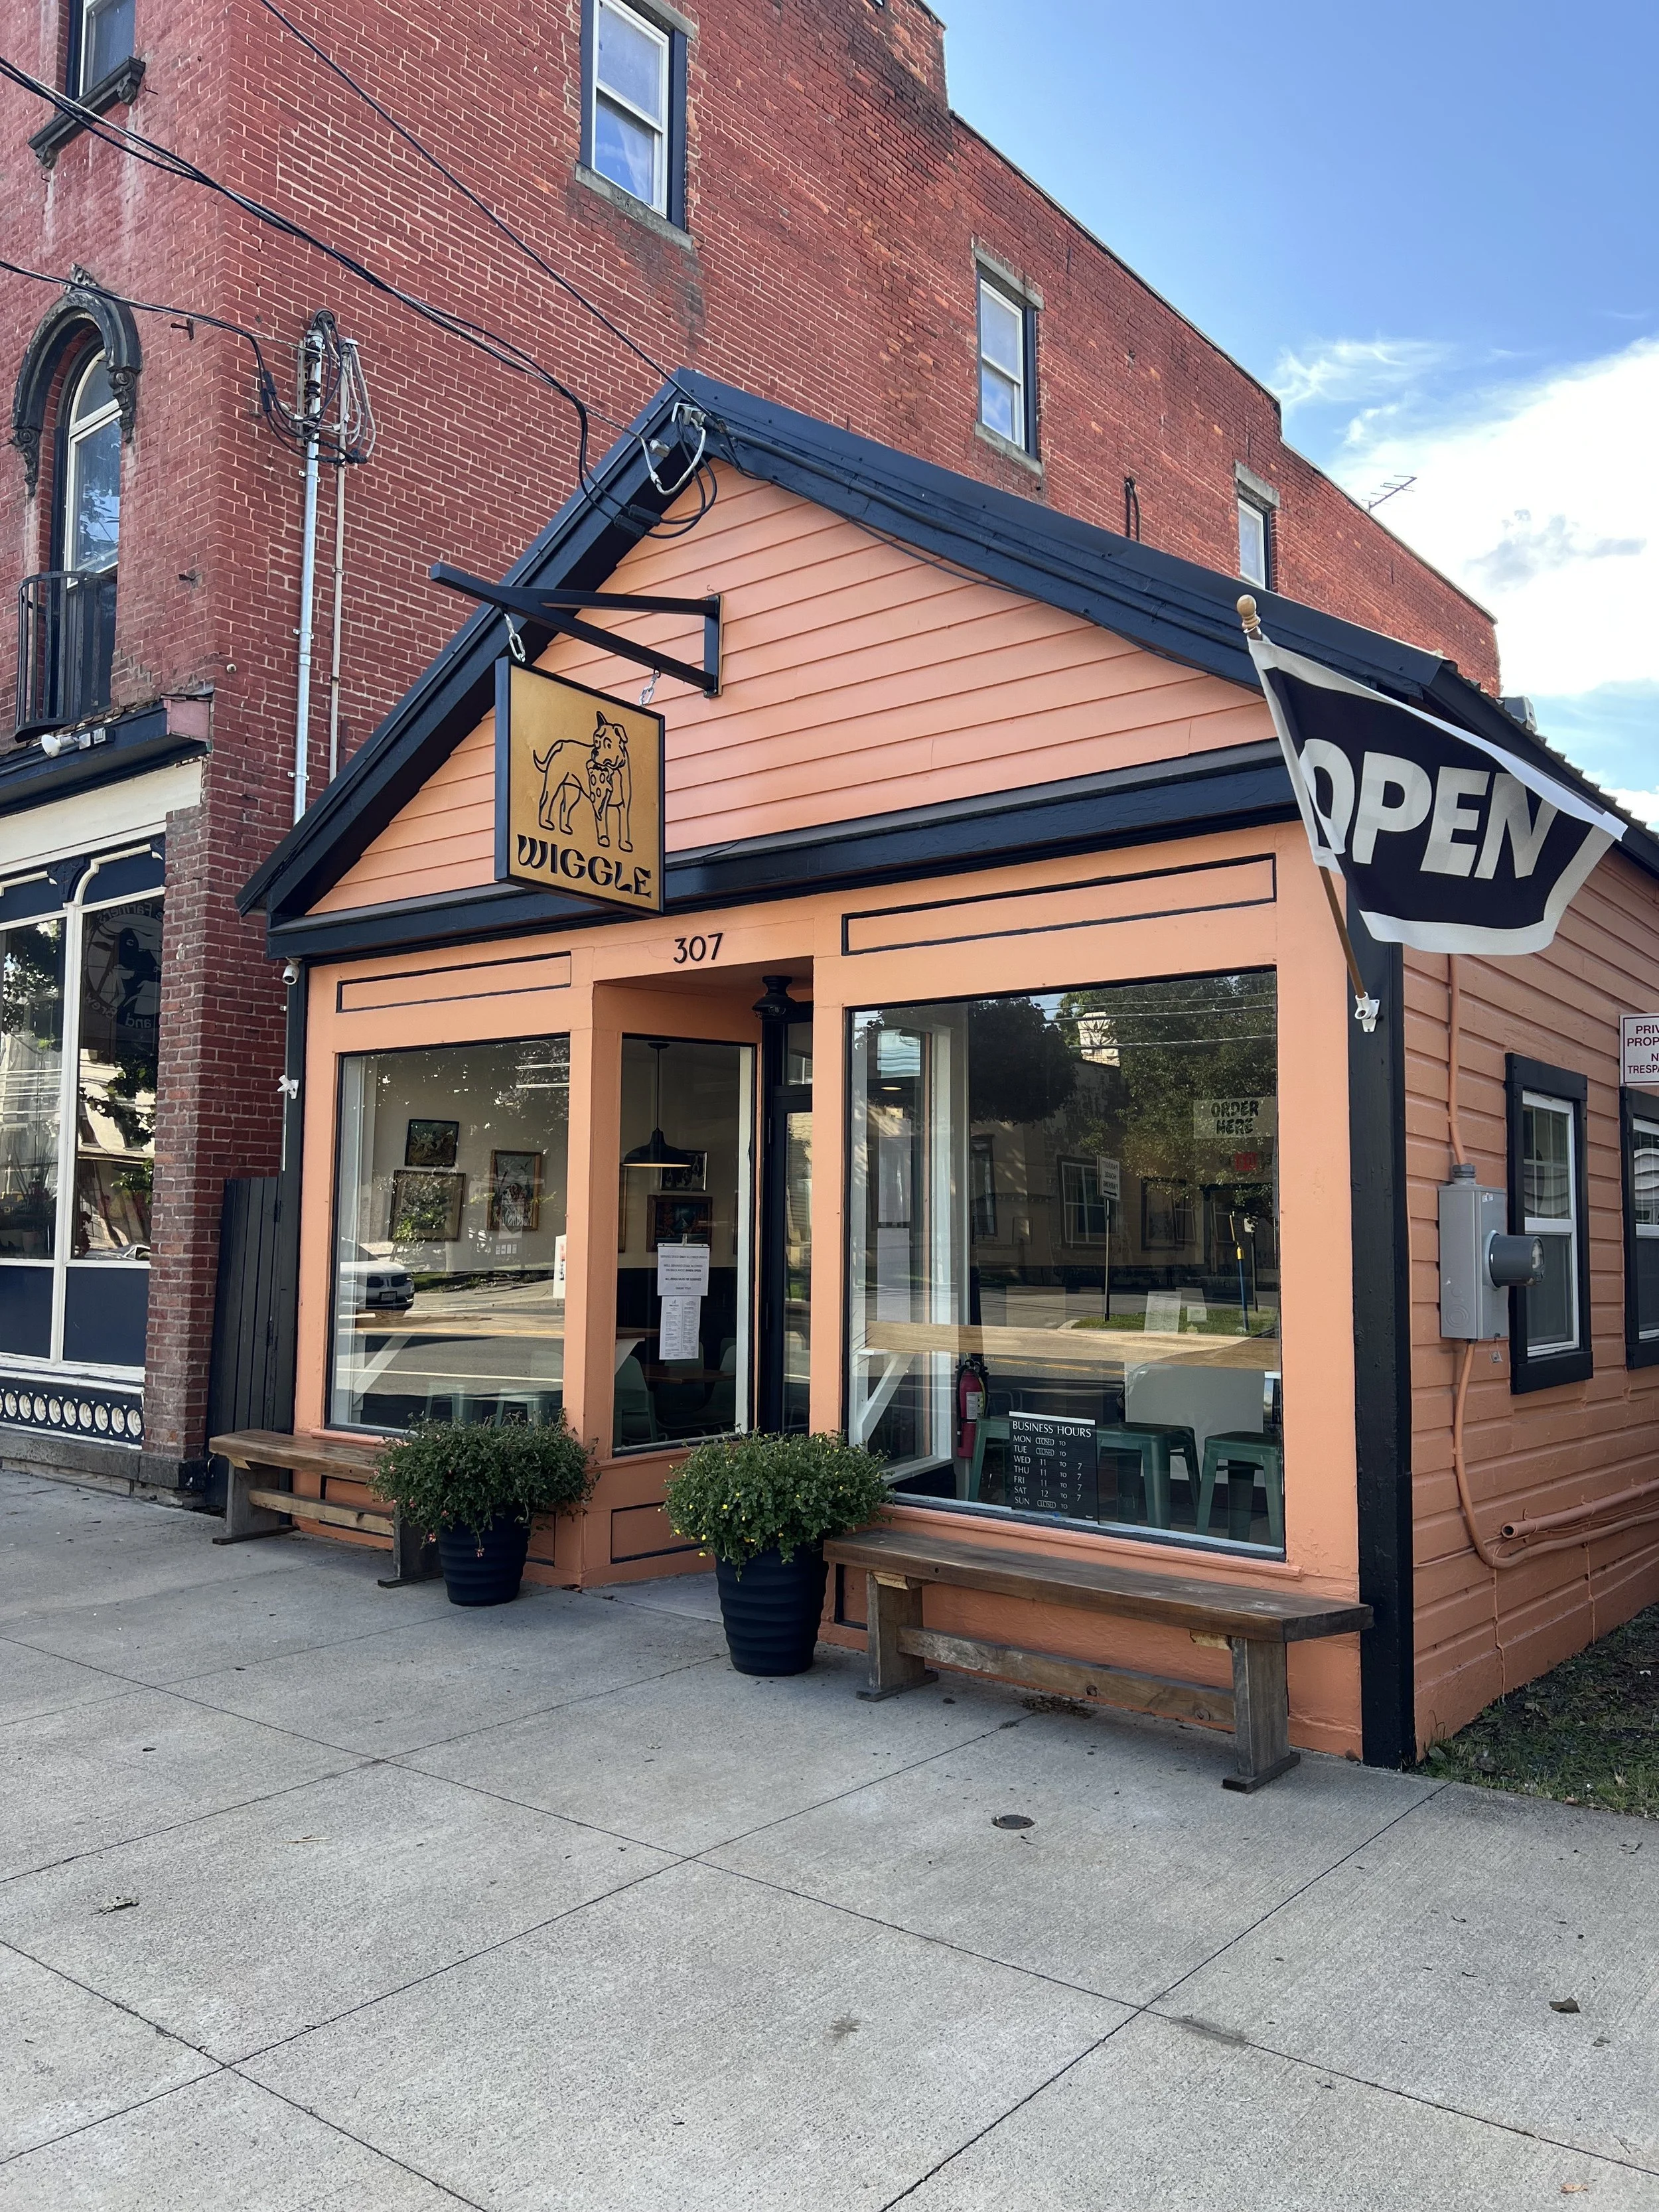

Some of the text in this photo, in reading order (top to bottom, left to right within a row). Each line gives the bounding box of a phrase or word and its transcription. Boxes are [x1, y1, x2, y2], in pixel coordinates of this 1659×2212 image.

[1299, 738, 1559, 879] OPEN
[517, 834, 652, 899] WIGGLE
[673, 932, 723, 964] 307
[1627, 1037, 1659, 1047] PROP
[1211, 1100, 1259, 1117] ORDER
[1216, 1118, 1253, 1135] HERE
[1013, 1420, 1092, 1438] BUSINESS HOURS
[1013, 1434, 1031, 1443] MON
[1035, 1437, 1054, 1446] CLOSED
[1013, 1444, 1027, 1453] TUE
[1035, 1447, 1055, 1457] CLOSED
[1013, 1455, 1031, 1464] WED
[1013, 1465, 1029, 1474] THU
[1014, 1475, 1025, 1484] FRI
[1014, 1485, 1027, 1495] SAT
[1041, 1489, 1048, 1498] 12
[1015, 1496, 1030, 1505] SUN
[1037, 1499, 1056, 1509] CLOSED
